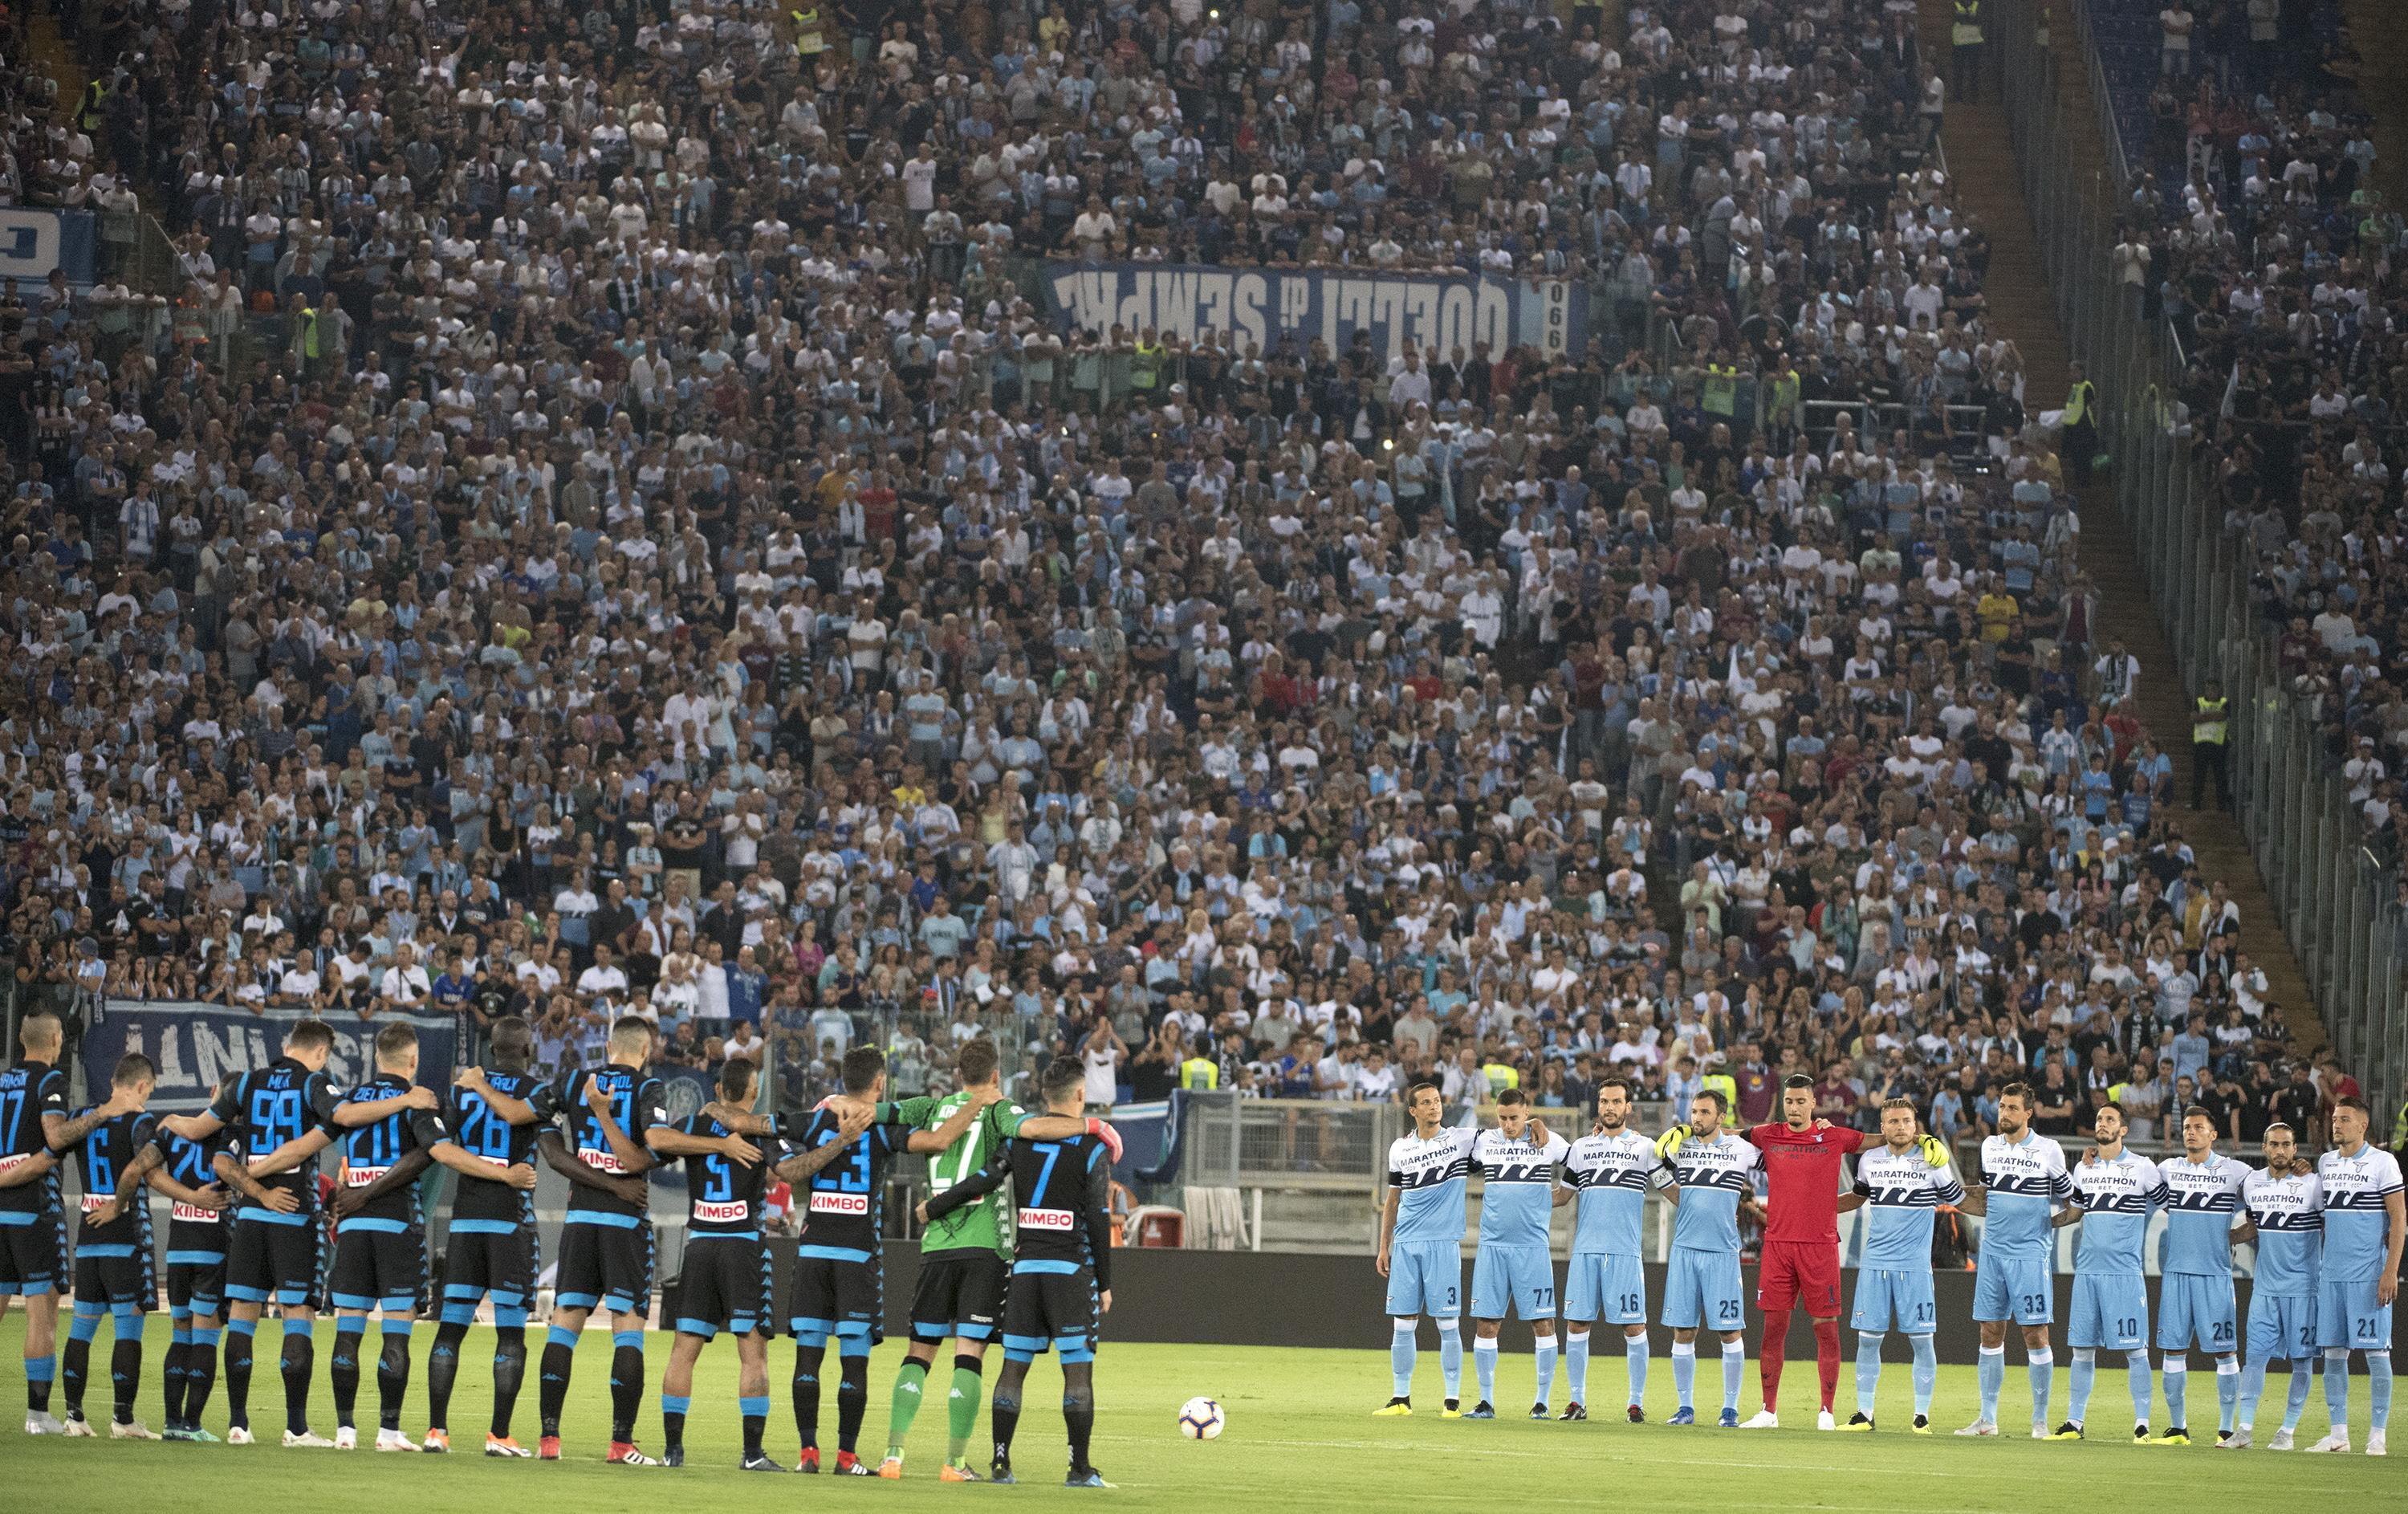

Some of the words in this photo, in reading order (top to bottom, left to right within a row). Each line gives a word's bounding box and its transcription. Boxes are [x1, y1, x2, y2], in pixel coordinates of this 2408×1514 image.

[250, 1089, 303, 1154] 99
[460, 1092, 510, 1158] 26
[1401, 1145, 1458, 1166] MARATHON
[1486, 1148, 1544, 1156] MARATHON
[1584, 1151, 1640, 1162] MARATHON
[1678, 1152, 1738, 1162] MARATHON
[87, 1128, 116, 1195] 6
[1422, 1160, 1436, 1168] BET
[1031, 1142, 1062, 1207] 7
[1871, 1171, 1926, 1180] MARATHON
[2081, 1177, 2137, 1186] MARATHON
[2170, 1174, 2227, 1184] MARATHON
[812, 1195, 867, 1211] KIMBO
[2251, 1195, 2304, 1205] MARATHON
[695, 1203, 746, 1218] KIMBO
[1020, 1212, 1072, 1227] KIMBO
[1447, 1287, 1457, 1305] 3
[1533, 1288, 1553, 1307] 77
[1620, 1293, 1638, 1312] 16
[2024, 1294, 2045, 1314] 33
[1719, 1300, 1739, 1318] 25
[1917, 1302, 1934, 1321] 17
[2117, 1318, 2137, 1337] 10
[2212, 1321, 2234, 1341] 26
[2357, 1318, 2376, 1337] 21
